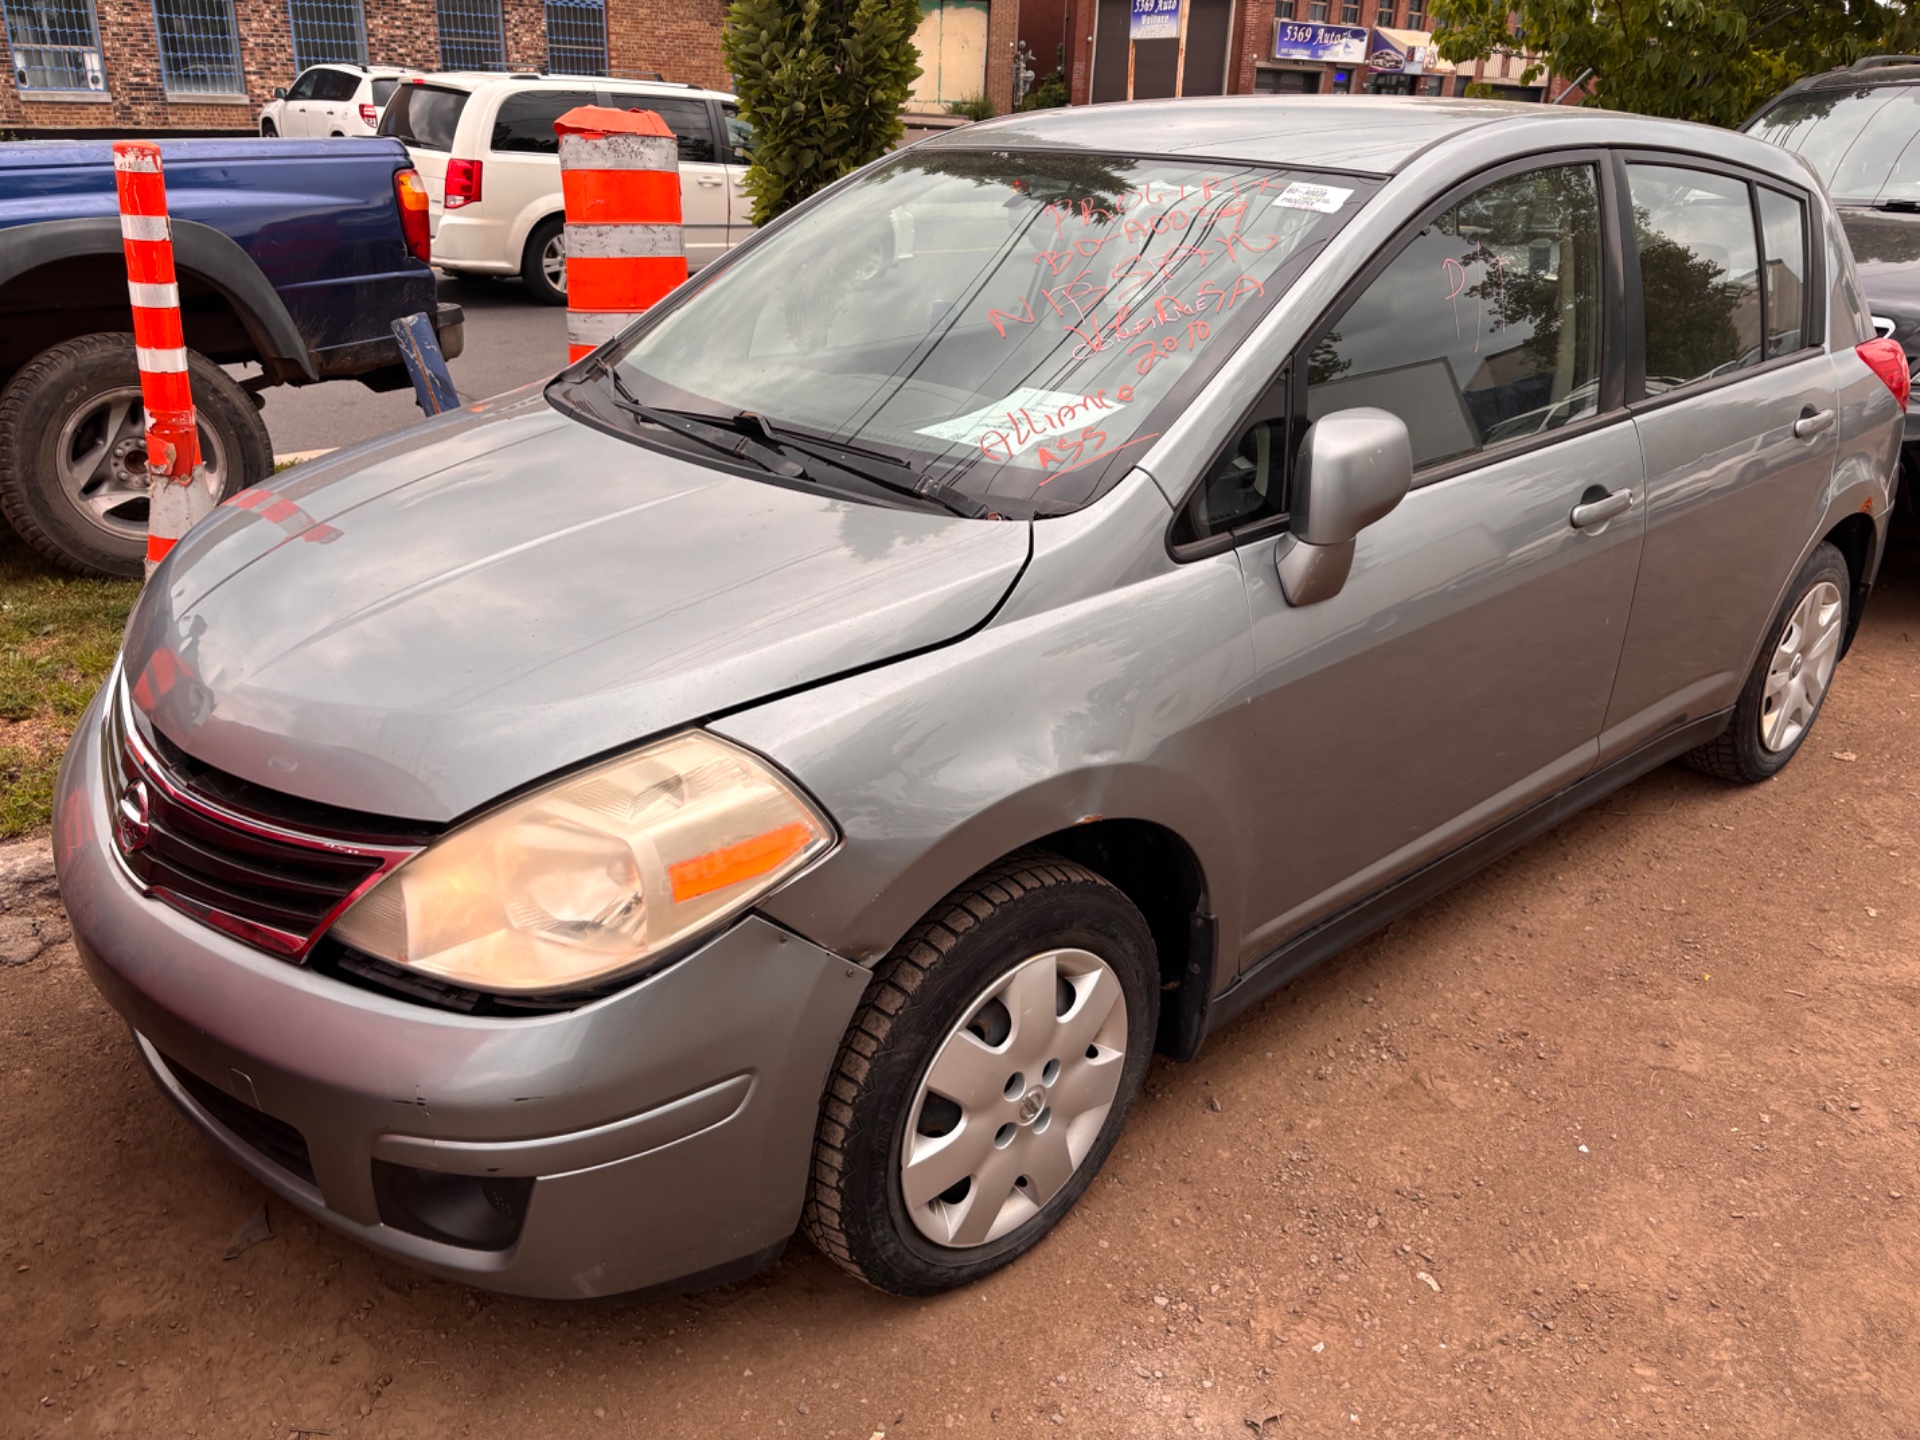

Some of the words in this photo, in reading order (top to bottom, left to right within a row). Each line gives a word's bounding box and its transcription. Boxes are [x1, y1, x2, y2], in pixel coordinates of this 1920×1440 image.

[1284, 25, 1312, 43] 5369
[1313, 28, 1341, 46] Auto
[1128, 321, 1210, 374] 2010
[1037, 426, 1107, 469] ASS
